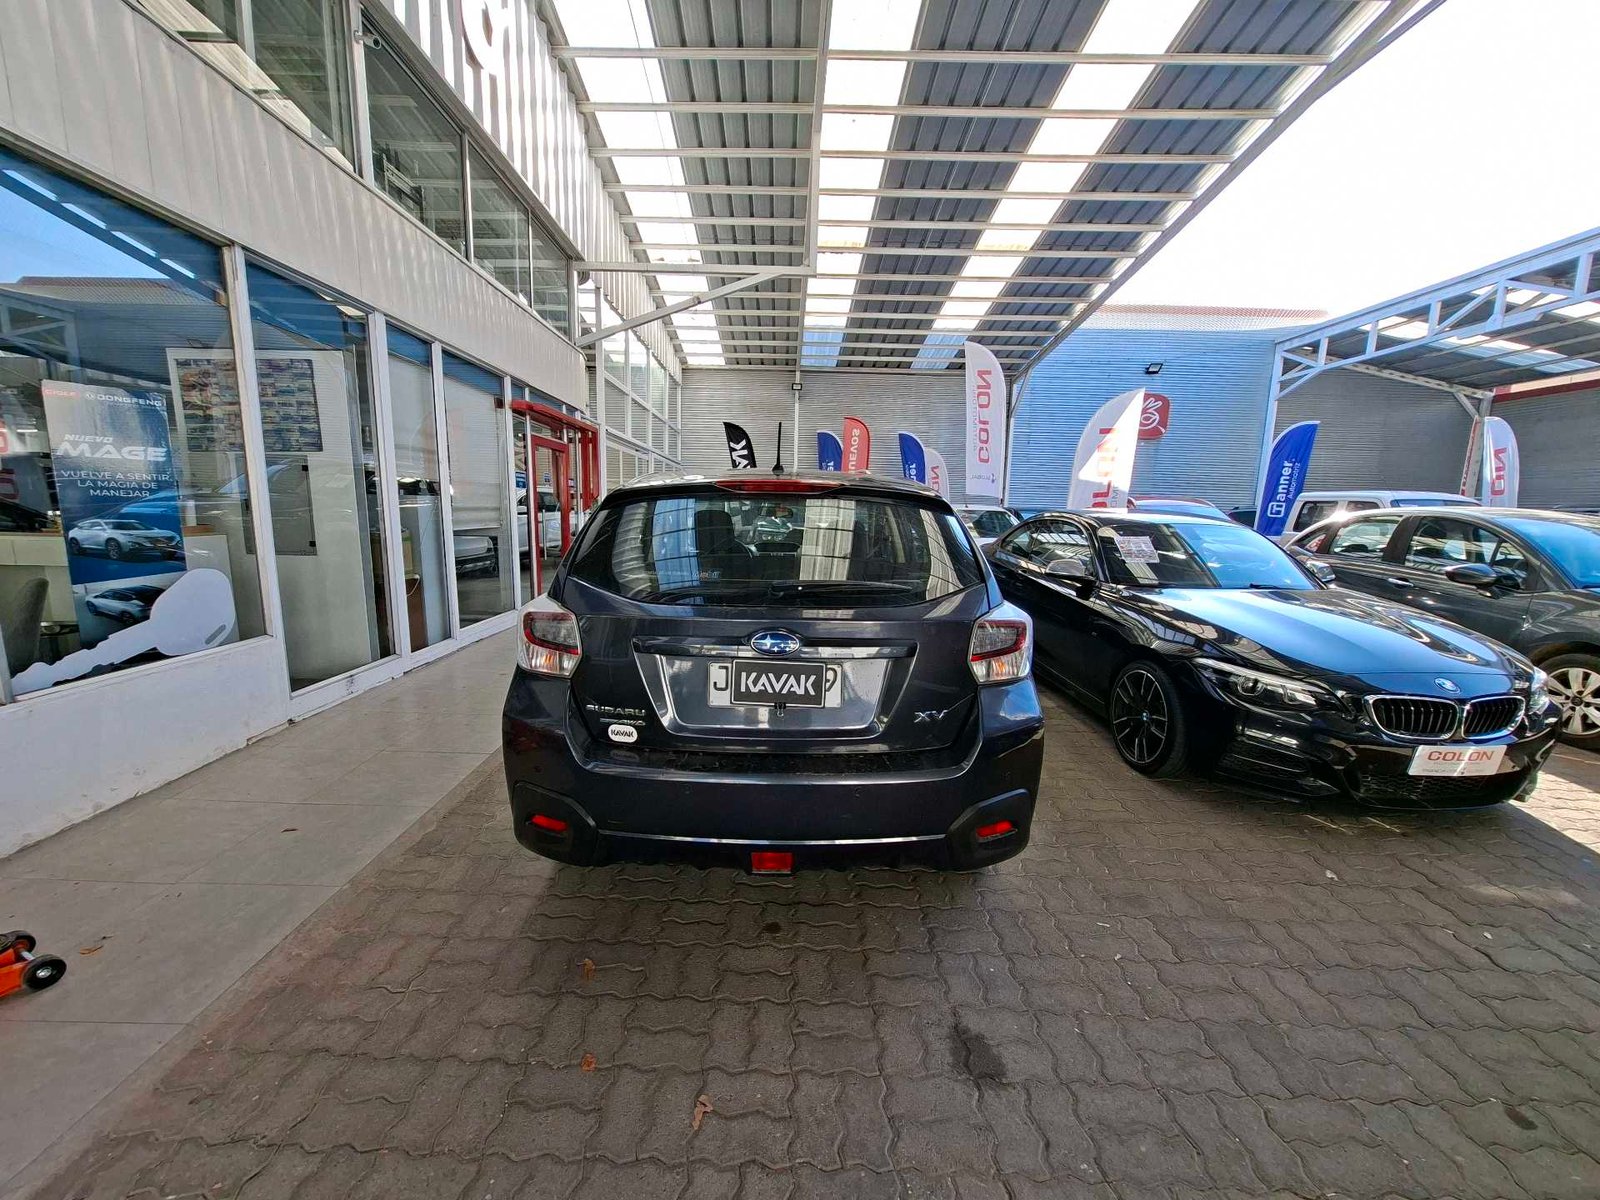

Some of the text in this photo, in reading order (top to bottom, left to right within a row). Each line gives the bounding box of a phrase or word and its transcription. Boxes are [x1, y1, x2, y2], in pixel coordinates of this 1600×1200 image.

[97, 394, 161, 406] DONGFENG
[64, 434, 113, 442] NUEVO
[56, 442, 168, 461] MAGE
[60, 470, 112, 479] VUELVE
[116, 472, 125, 480] A
[97, 480, 139, 488] MAGIA
[142, 481, 158, 489] DE
[740, 671, 816, 695] KAVAK
[586, 704, 646, 716] SUBARU
[913, 709, 949, 722] XV
[611, 729, 634, 738] KAVAK
[1427, 750, 1495, 761] COLON
